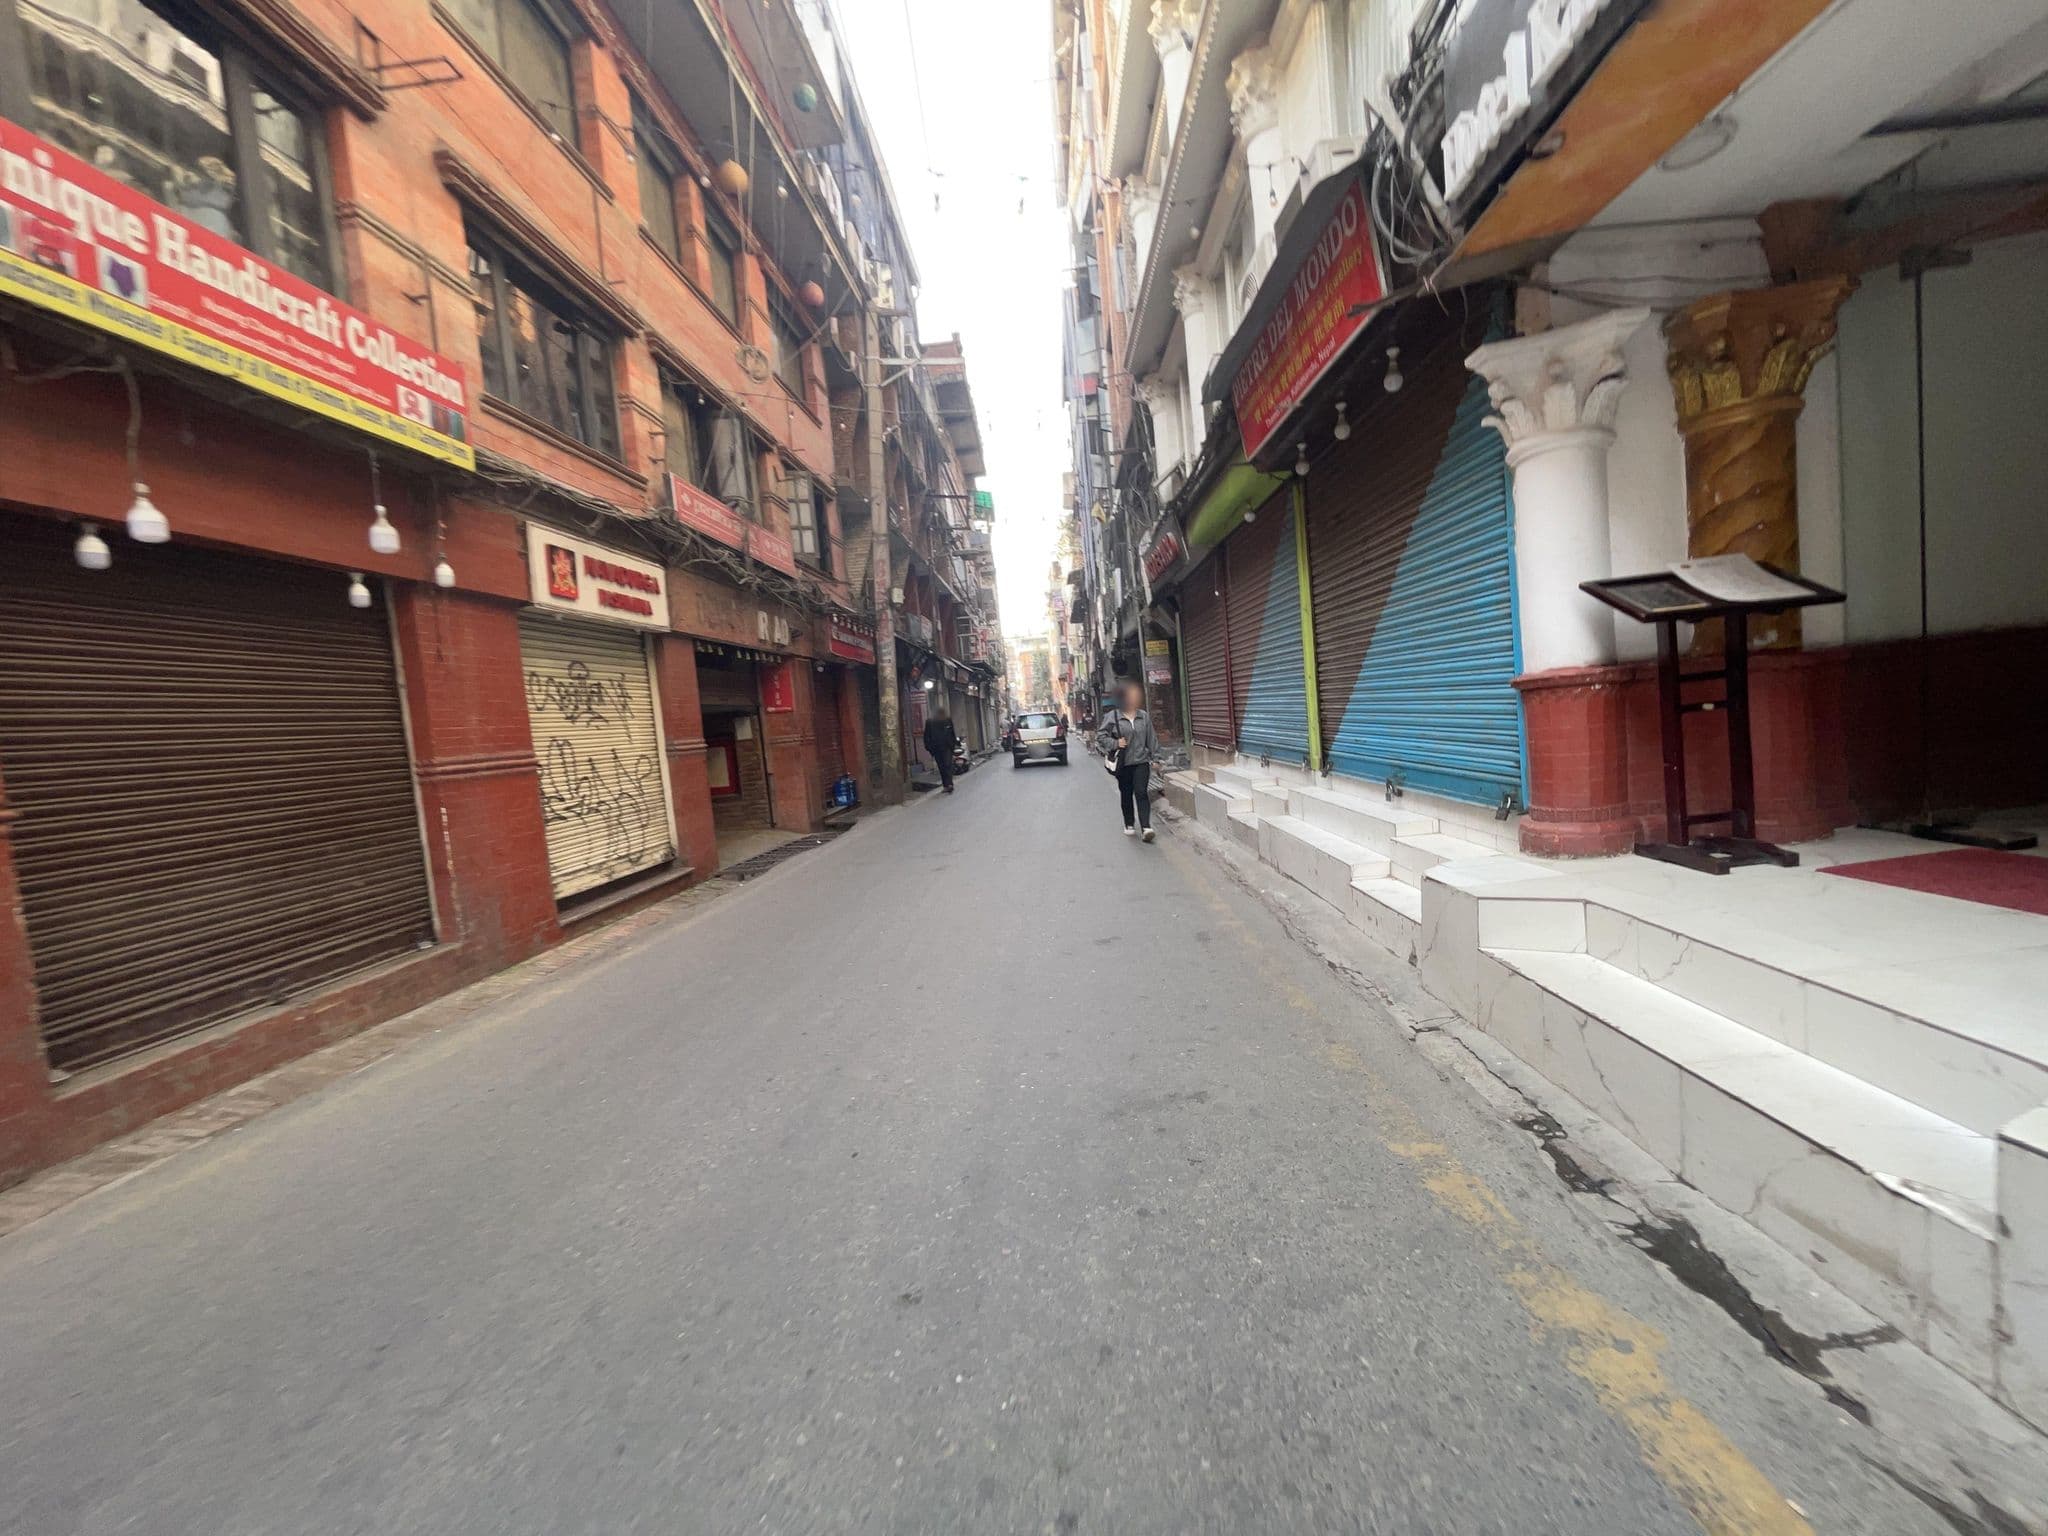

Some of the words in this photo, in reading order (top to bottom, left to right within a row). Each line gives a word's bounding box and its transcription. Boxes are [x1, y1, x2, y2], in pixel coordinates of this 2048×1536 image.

[151, 211, 345, 352] Handicraft
[346, 319, 466, 408] Collection
[1232, 336, 1269, 407] PIETRE
[1268, 299, 1293, 350] DEL
[1294, 196, 1358, 311] MONDO
[1324, 244, 1363, 299] Jewellery
